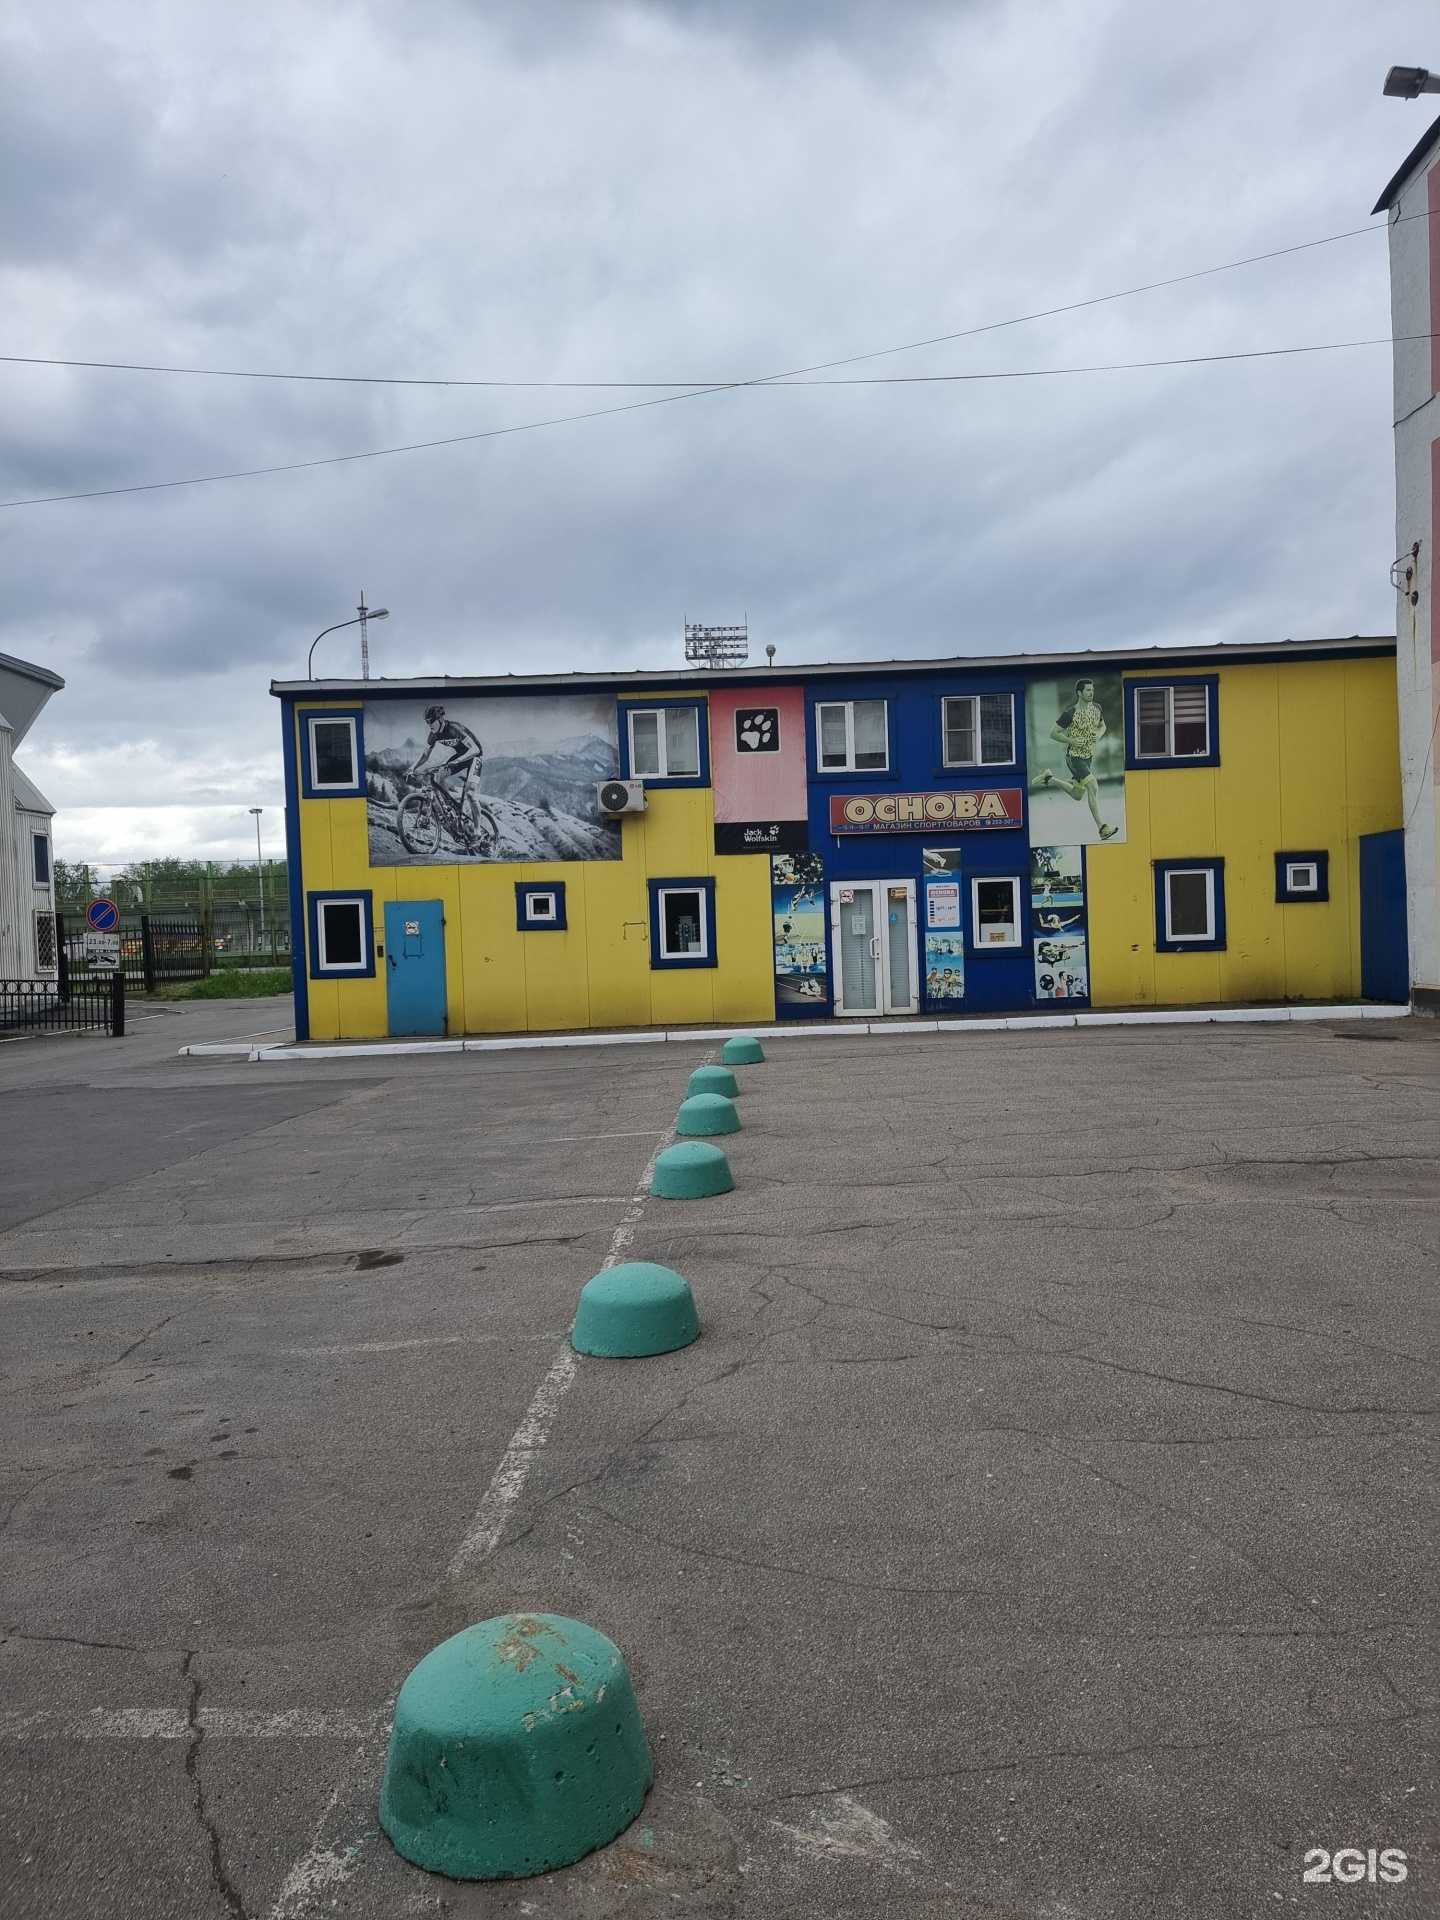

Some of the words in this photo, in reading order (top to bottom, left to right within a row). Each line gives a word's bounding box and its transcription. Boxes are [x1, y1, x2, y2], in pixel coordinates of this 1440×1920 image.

[844, 792, 1008, 823] ОСНОВА
[873, 822, 913, 831] МАГАЗИН
[914, 818, 981, 829] СПОРТТОВАРОВ
[743, 828, 762, 836] Jack
[743, 834, 777, 843] Wolfskin
